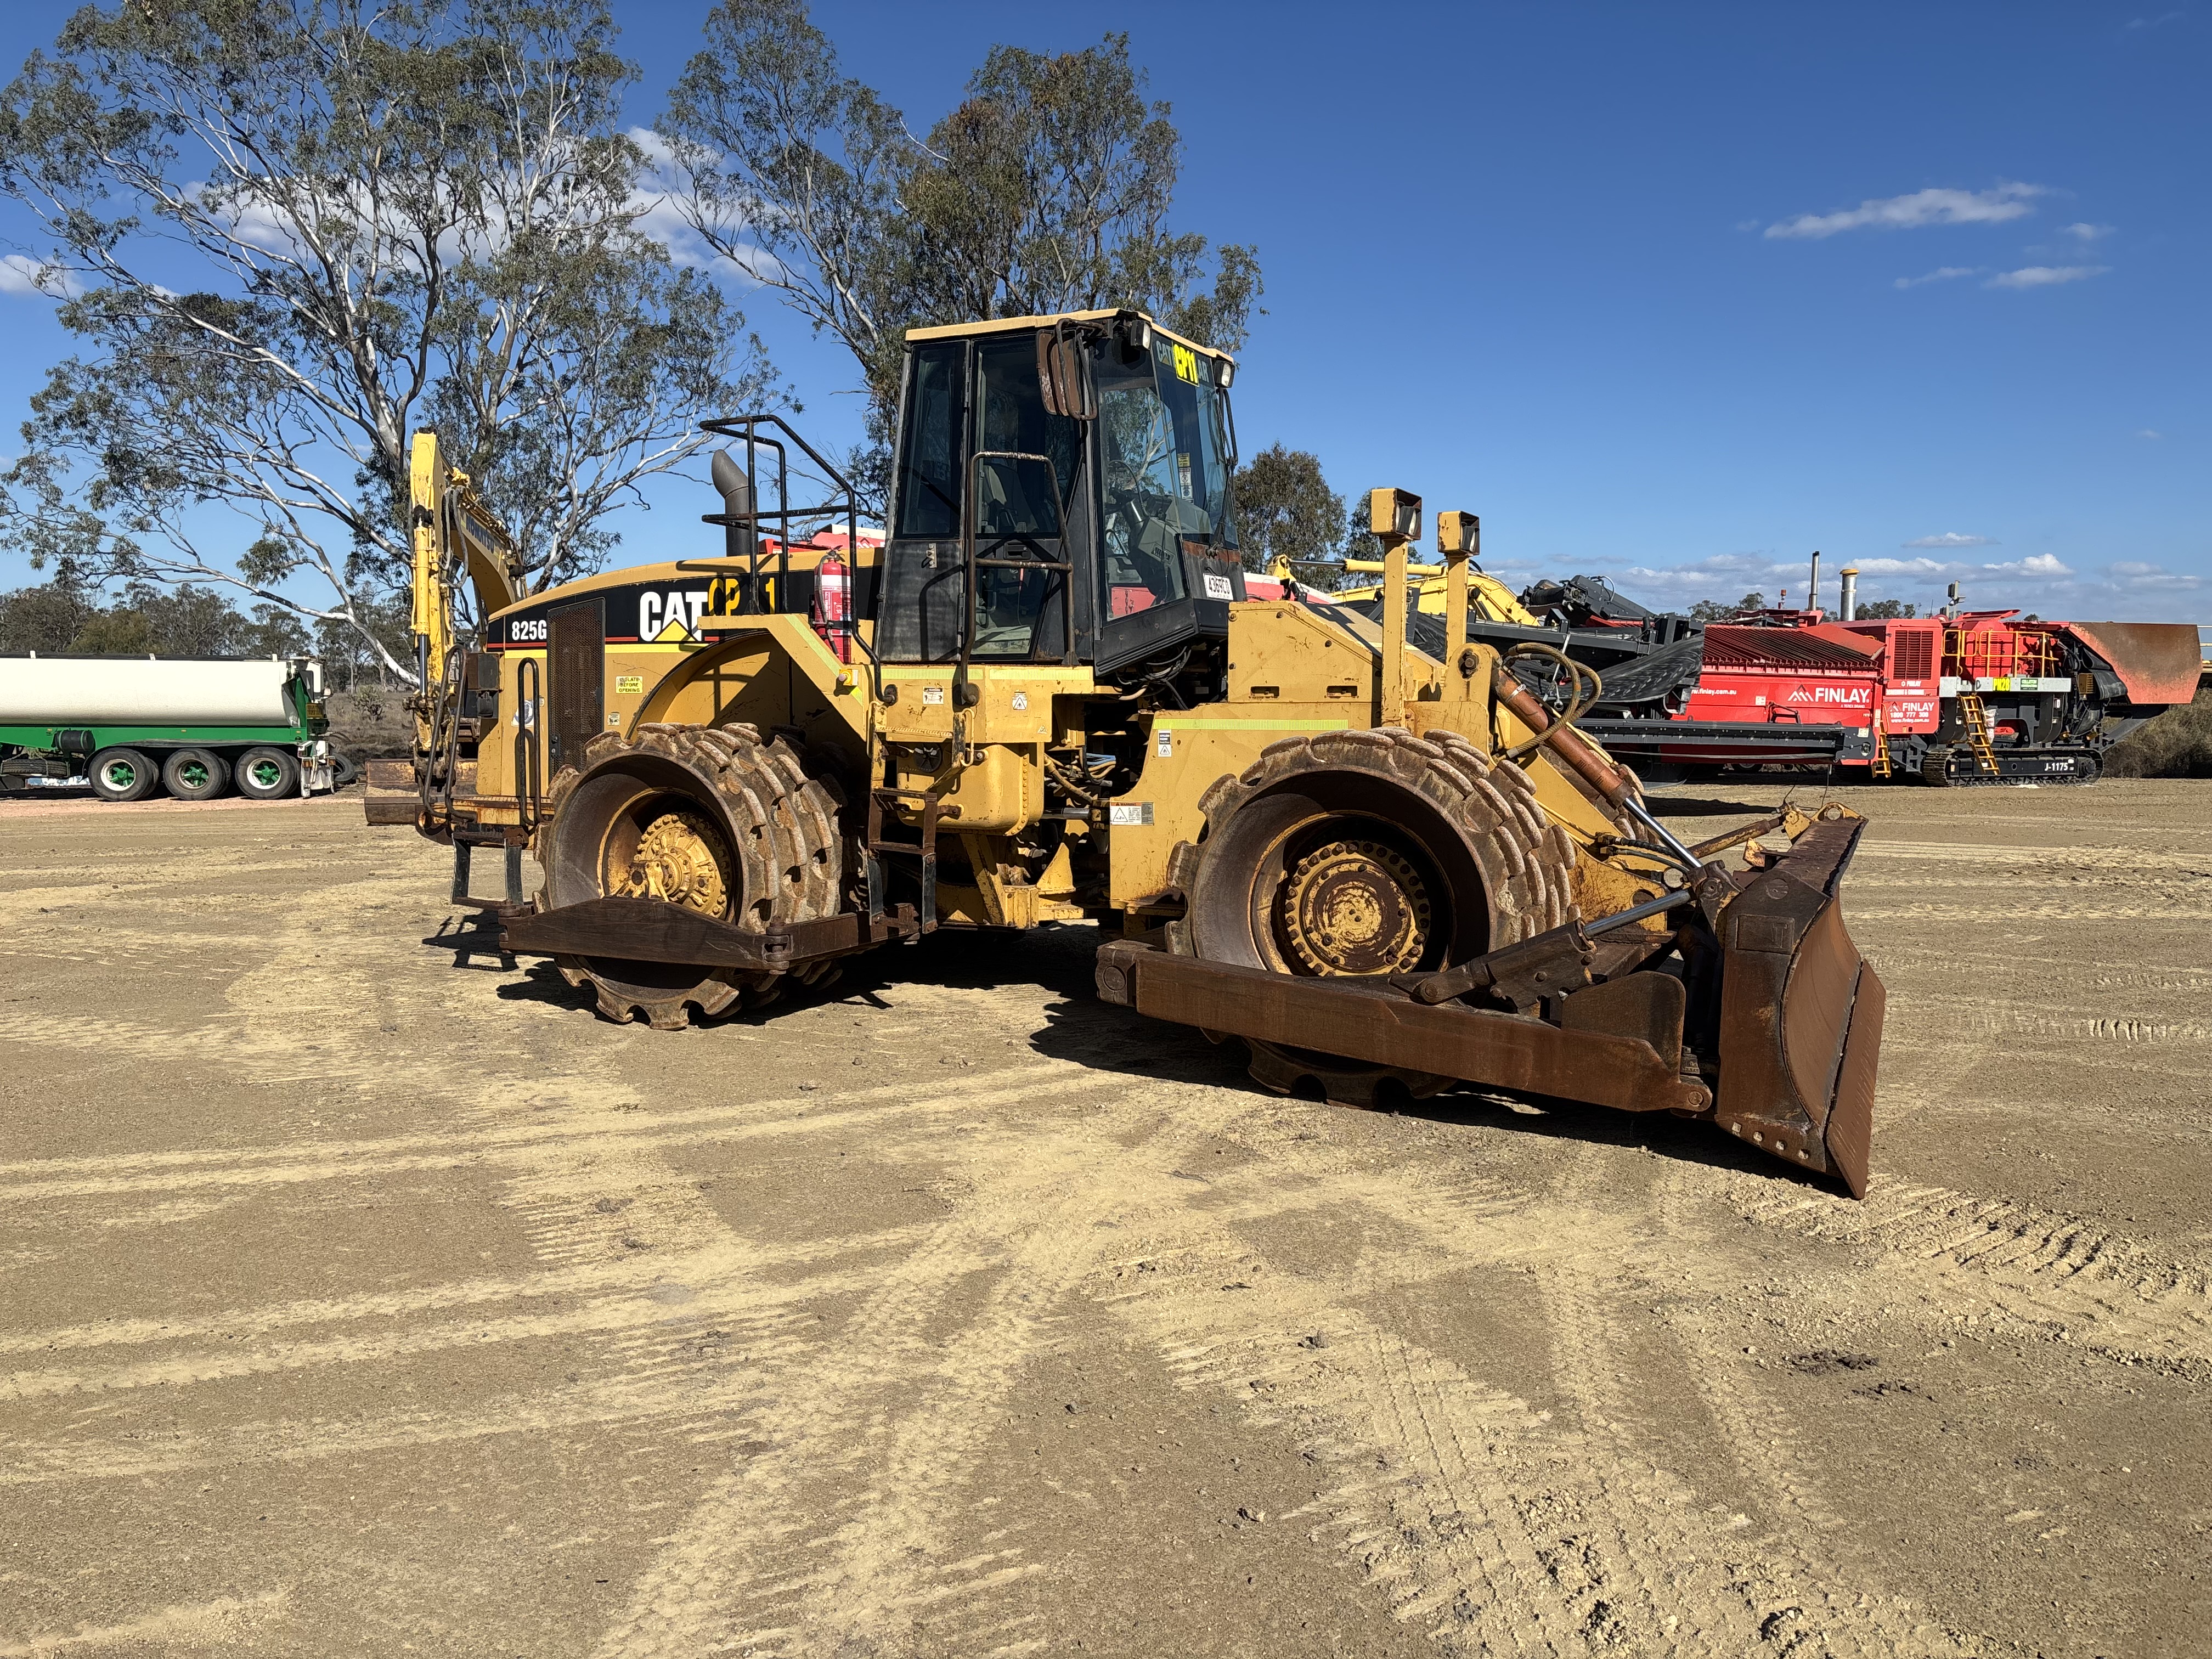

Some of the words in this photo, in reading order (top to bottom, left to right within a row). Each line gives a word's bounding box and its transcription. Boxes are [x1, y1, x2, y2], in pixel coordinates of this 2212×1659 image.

[1173, 343, 1198, 383] CP11
[466, 515, 494, 554] KOMATSU
[708, 577, 775, 617] CP1
[640, 591, 708, 642] CAT
[512, 619, 547, 641] 825G
[1815, 687, 1870, 703] FINLAY
[1993, 678, 2010, 691] PN28
[1902, 702, 1934, 712] FINLAY
[2044, 762, 2068, 771] J-1175
